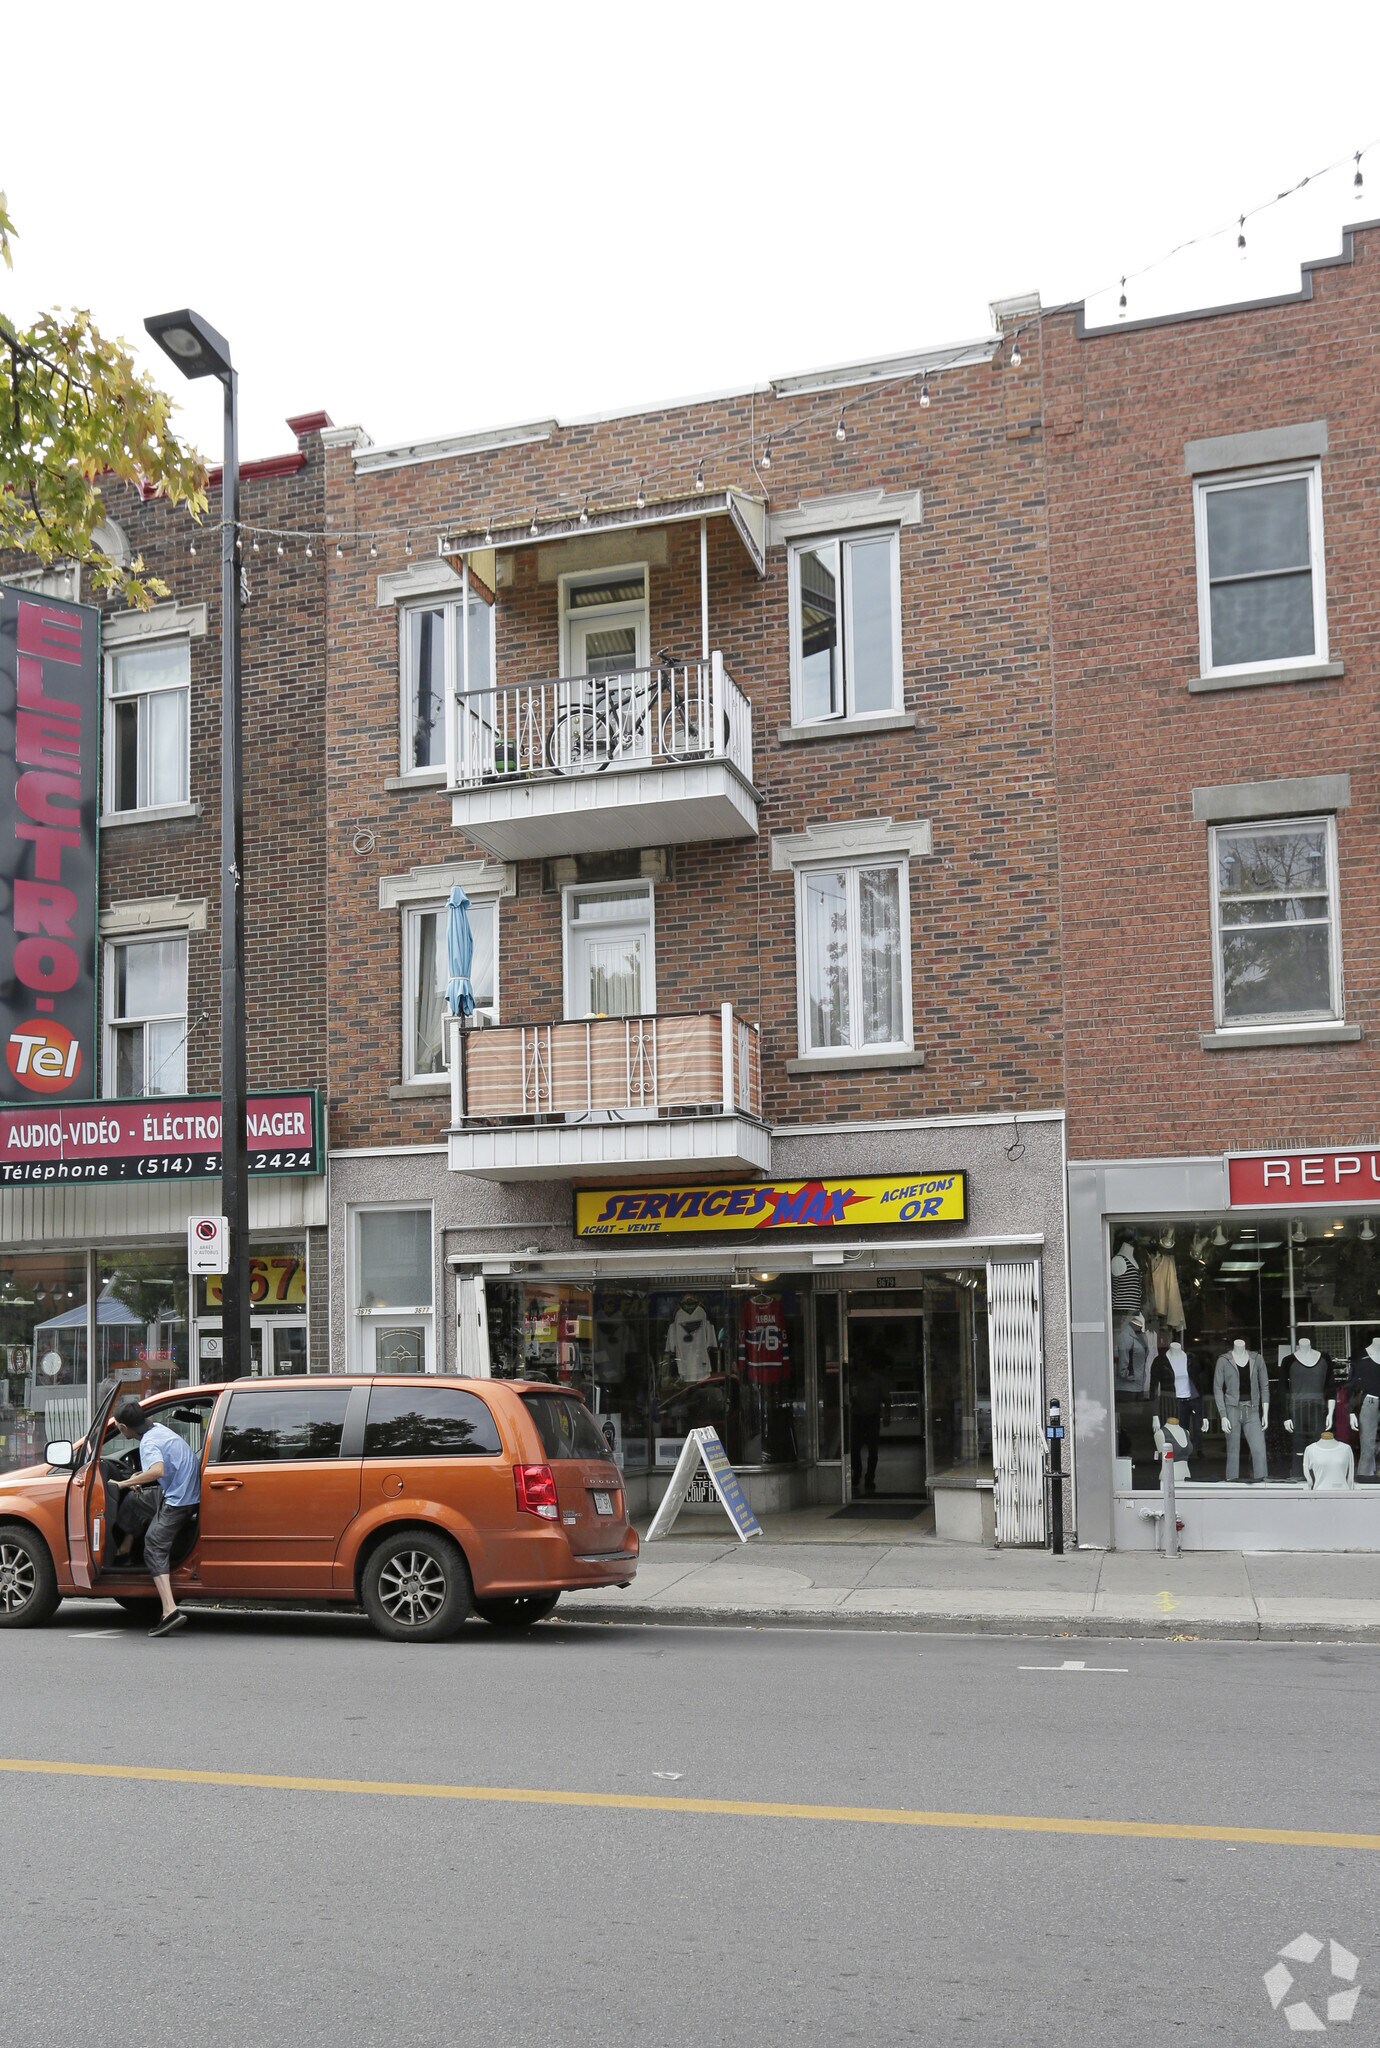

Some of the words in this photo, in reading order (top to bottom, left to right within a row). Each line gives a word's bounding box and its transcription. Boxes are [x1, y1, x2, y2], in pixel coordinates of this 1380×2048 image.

[8, 1033, 80, 1080] Tel
[7, 1116, 120, 1148] AUDIO-VIDÉO
[143, 1112, 305, 1141] ÉLÉCTRONAGER
[2, 1163, 108, 1181] Téléphone
[137, 1157, 192, 1176] (514)
[880, 1176, 955, 1204] ACHETONS
[597, 1187, 775, 1222] SERVICES
[771, 1188, 856, 1224] MAX
[899, 1197, 943, 1221] OR
[582, 1225, 616, 1235] ACHAT
[627, 1223, 662, 1233] VENTE
[877, 1278, 894, 1287] 3679
[755, 1326, 779, 1352] 76
